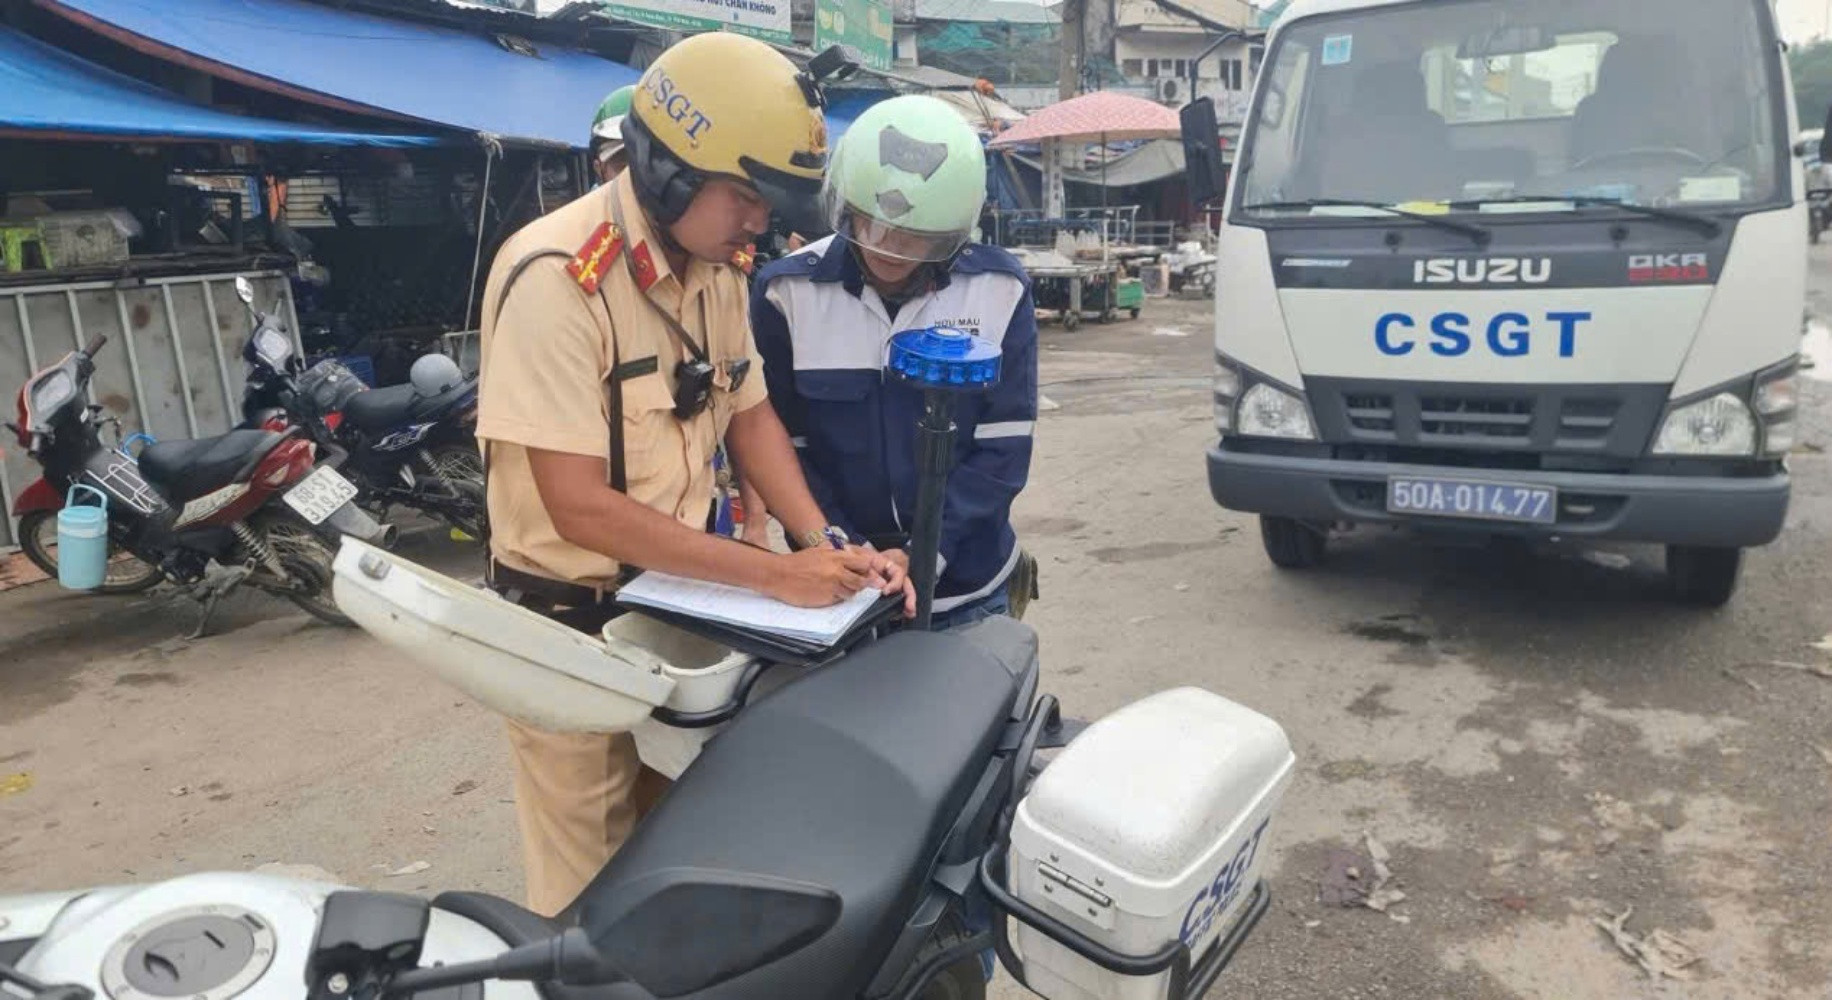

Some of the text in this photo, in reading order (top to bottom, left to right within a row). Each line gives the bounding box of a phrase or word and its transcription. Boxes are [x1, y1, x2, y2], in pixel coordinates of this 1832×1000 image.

[646, 67, 712, 140] CSGT
[1413, 257, 1552, 283] ISUZU
[1374, 311, 1592, 358] CSGT
[1394, 481, 1550, 518] 50A-014.77
[1178, 814, 1271, 942] CSGT
